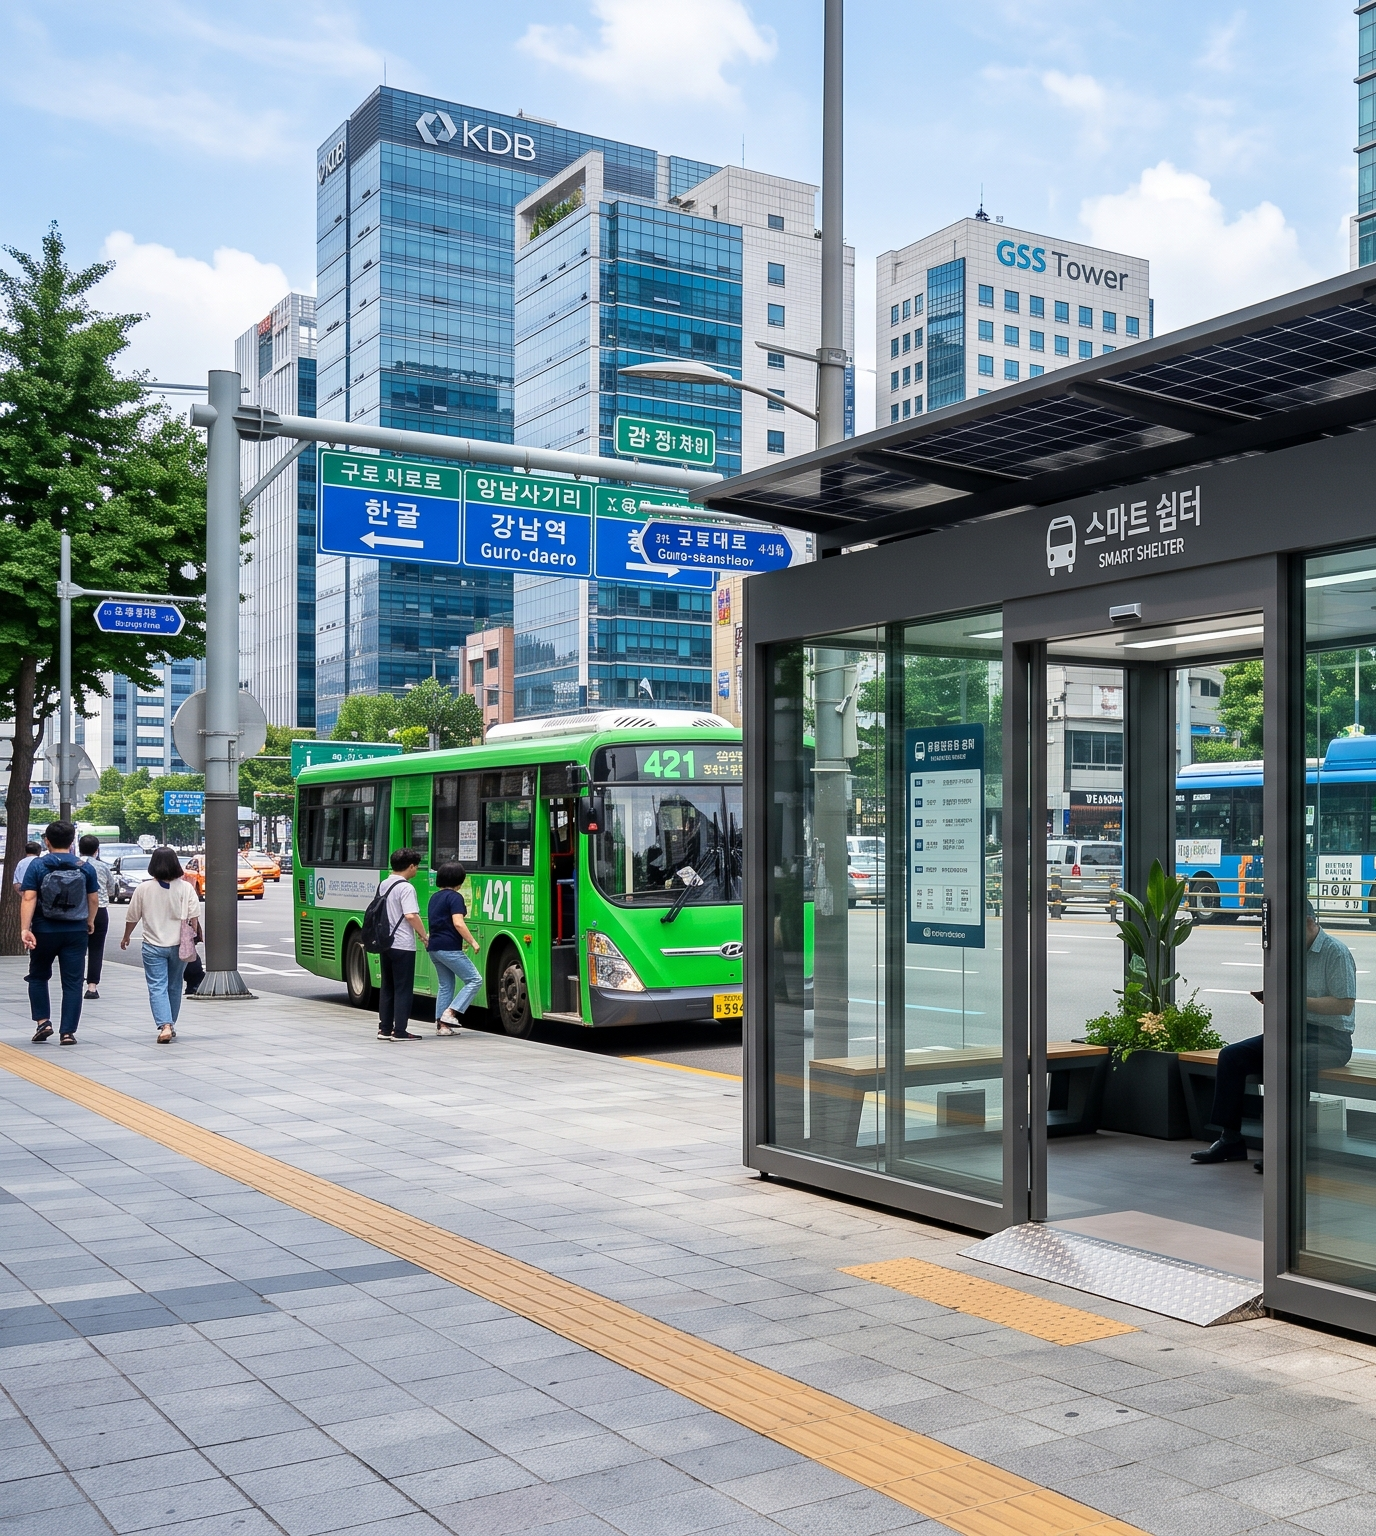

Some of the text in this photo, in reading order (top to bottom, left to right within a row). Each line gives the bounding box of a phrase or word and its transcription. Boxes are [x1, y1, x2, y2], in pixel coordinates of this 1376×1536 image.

[463, 120, 536, 161] KDB
[996, 239, 1128, 291] GSS Tower
[341, 462, 380, 482] 구로
[491, 513, 566, 545] 강남역
[1084, 485, 1201, 546] 스마트 쉼터
[480, 542, 577, 566] Guro-daero
[1098, 537, 1185, 568] SMART SHELTER
[643, 749, 695, 778] 421
[482, 879, 512, 922] 421
